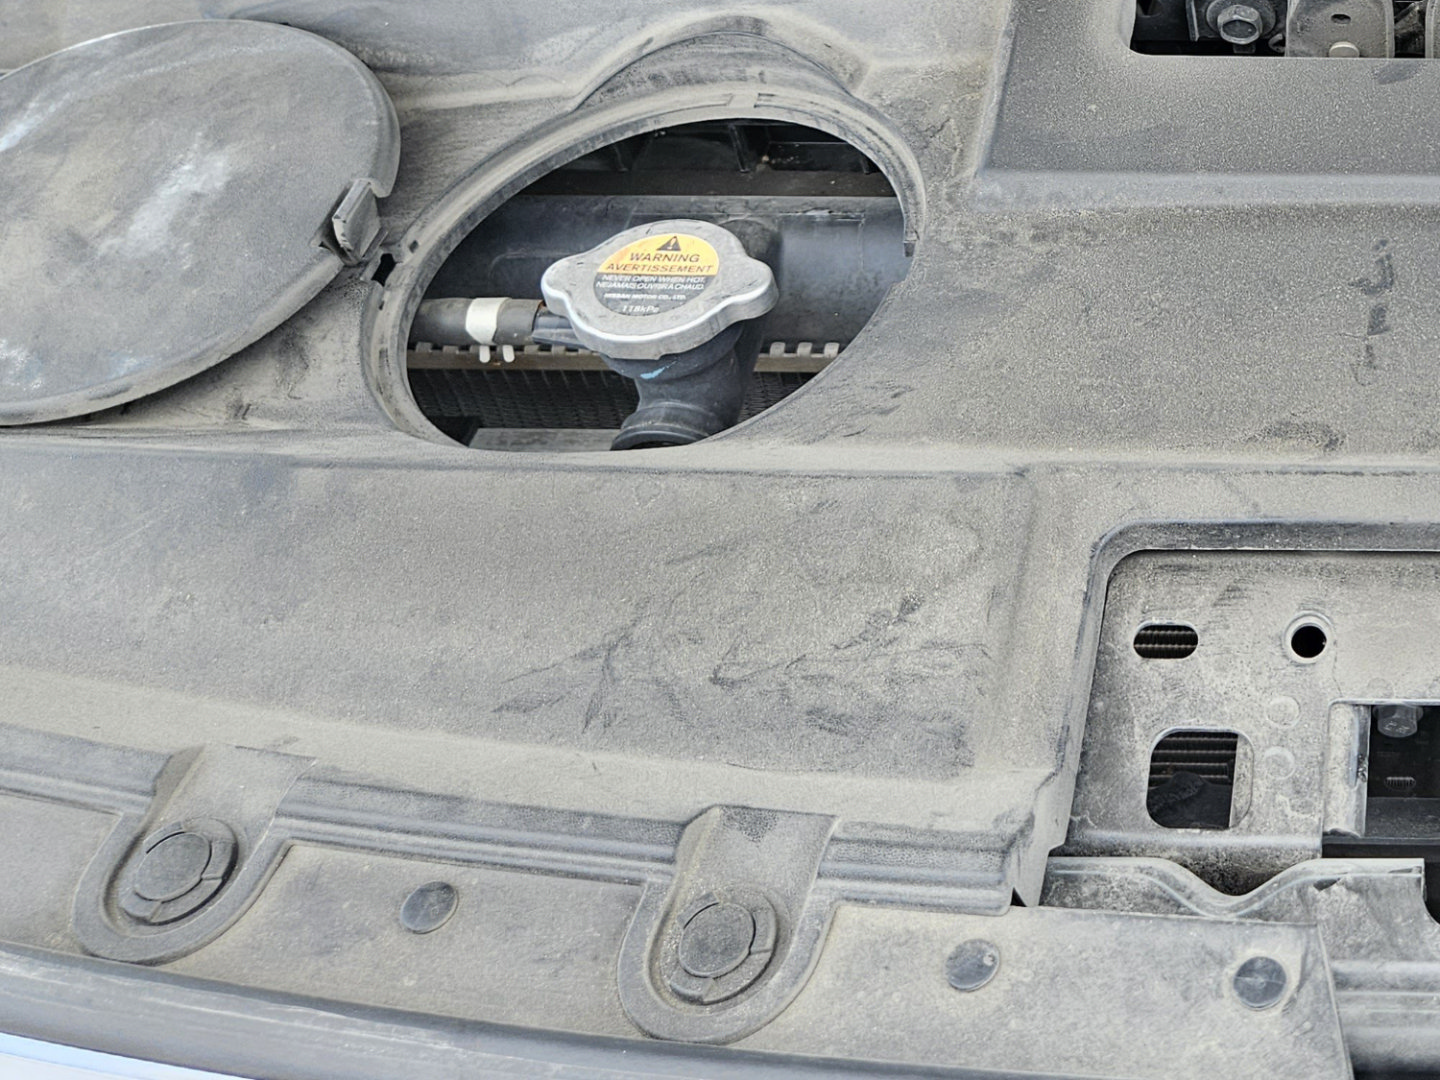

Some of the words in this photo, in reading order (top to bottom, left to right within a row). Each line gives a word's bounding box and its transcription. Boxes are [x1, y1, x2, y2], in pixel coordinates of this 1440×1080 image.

[629, 252, 700, 263] WARNING
[606, 263, 714, 273] AVERTISSEMENT
[601, 274, 631, 282] NEVER
